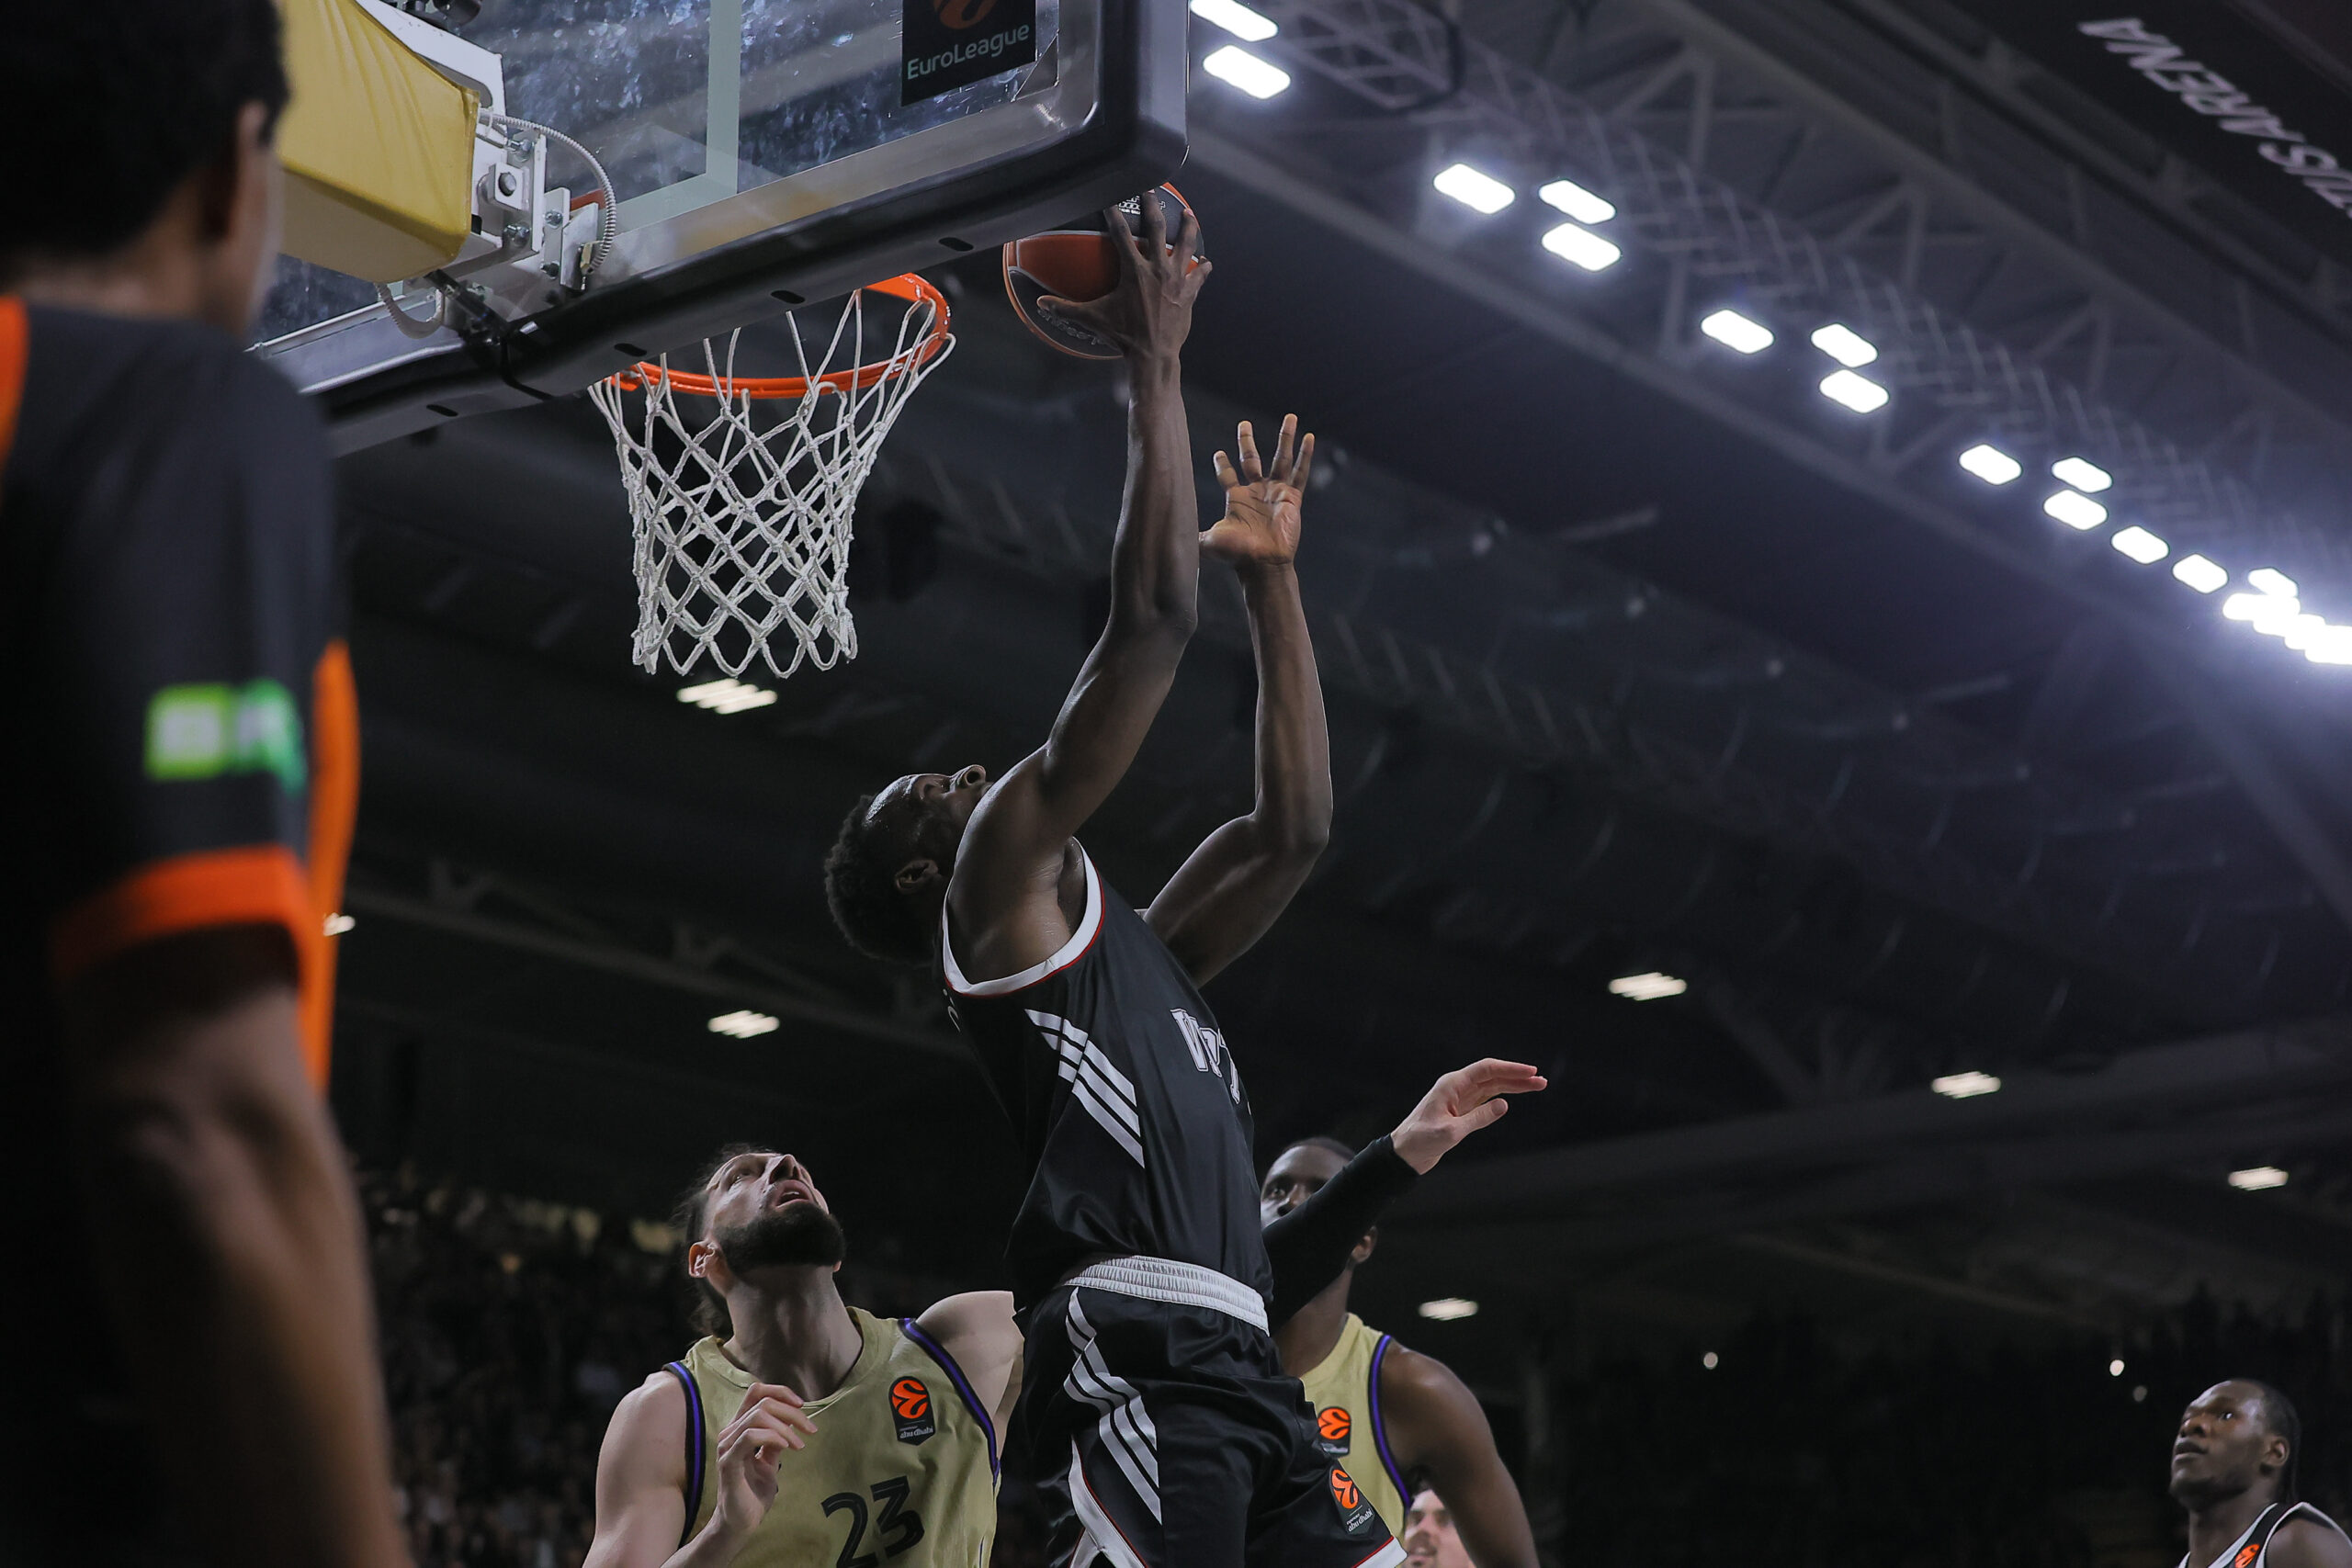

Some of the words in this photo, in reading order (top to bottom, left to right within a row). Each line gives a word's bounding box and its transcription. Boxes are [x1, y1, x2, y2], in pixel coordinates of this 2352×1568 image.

[908, 24, 1030, 80] EuroLeague
[2077, 17, 2307, 142] ARENA
[820, 1474, 925, 1568] 23
[1348, 1520, 1360, 1532] abu
[1359, 1508, 1374, 1525] dhabi
